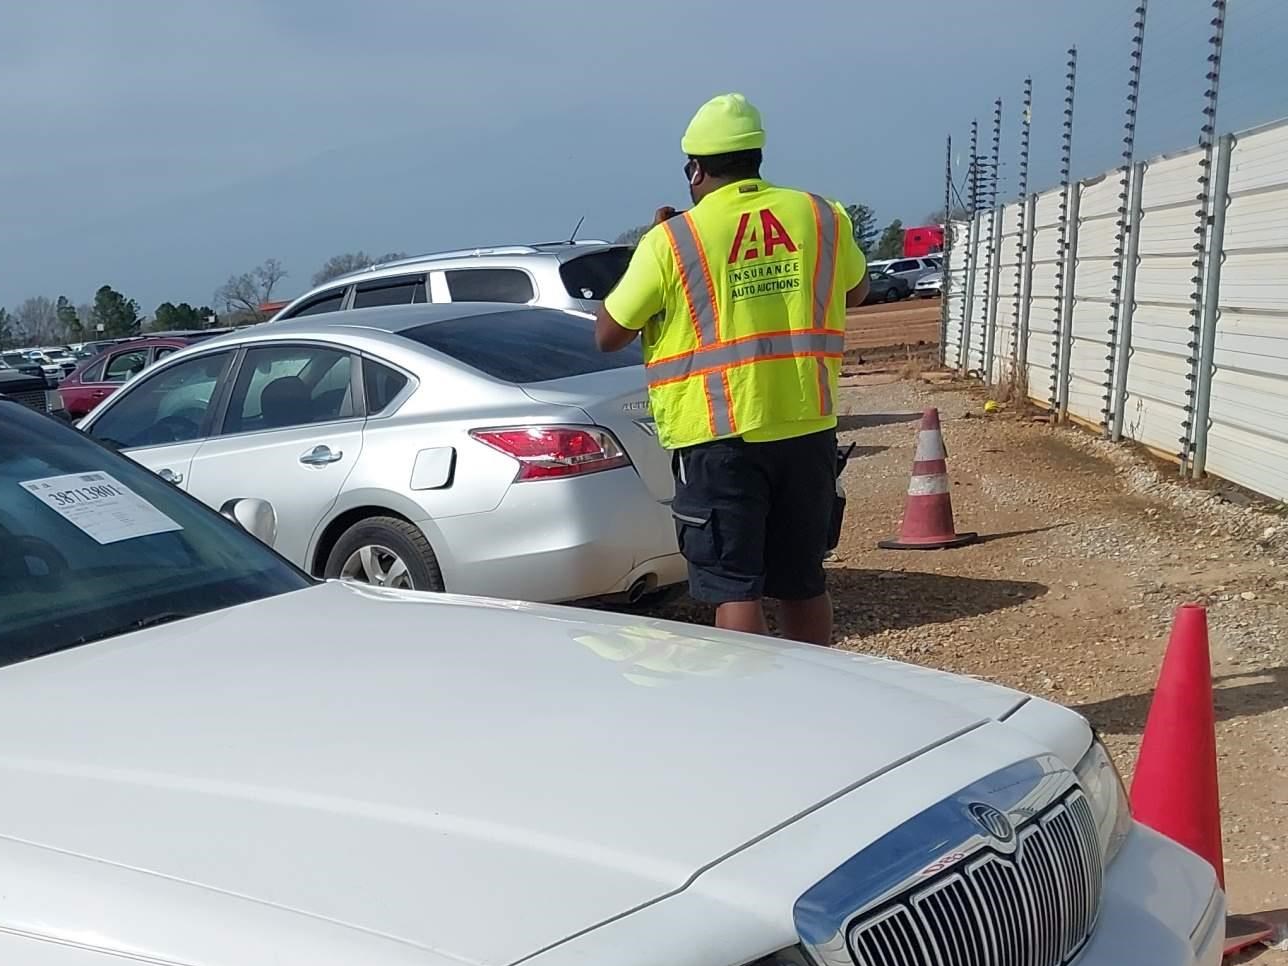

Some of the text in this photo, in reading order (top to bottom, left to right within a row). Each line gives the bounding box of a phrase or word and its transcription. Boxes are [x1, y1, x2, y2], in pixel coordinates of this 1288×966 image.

[729, 262, 799, 283] INSURANCE
[732, 278, 800, 298] AUTO AUCTIONS
[47, 484, 124, 506] 38713801
